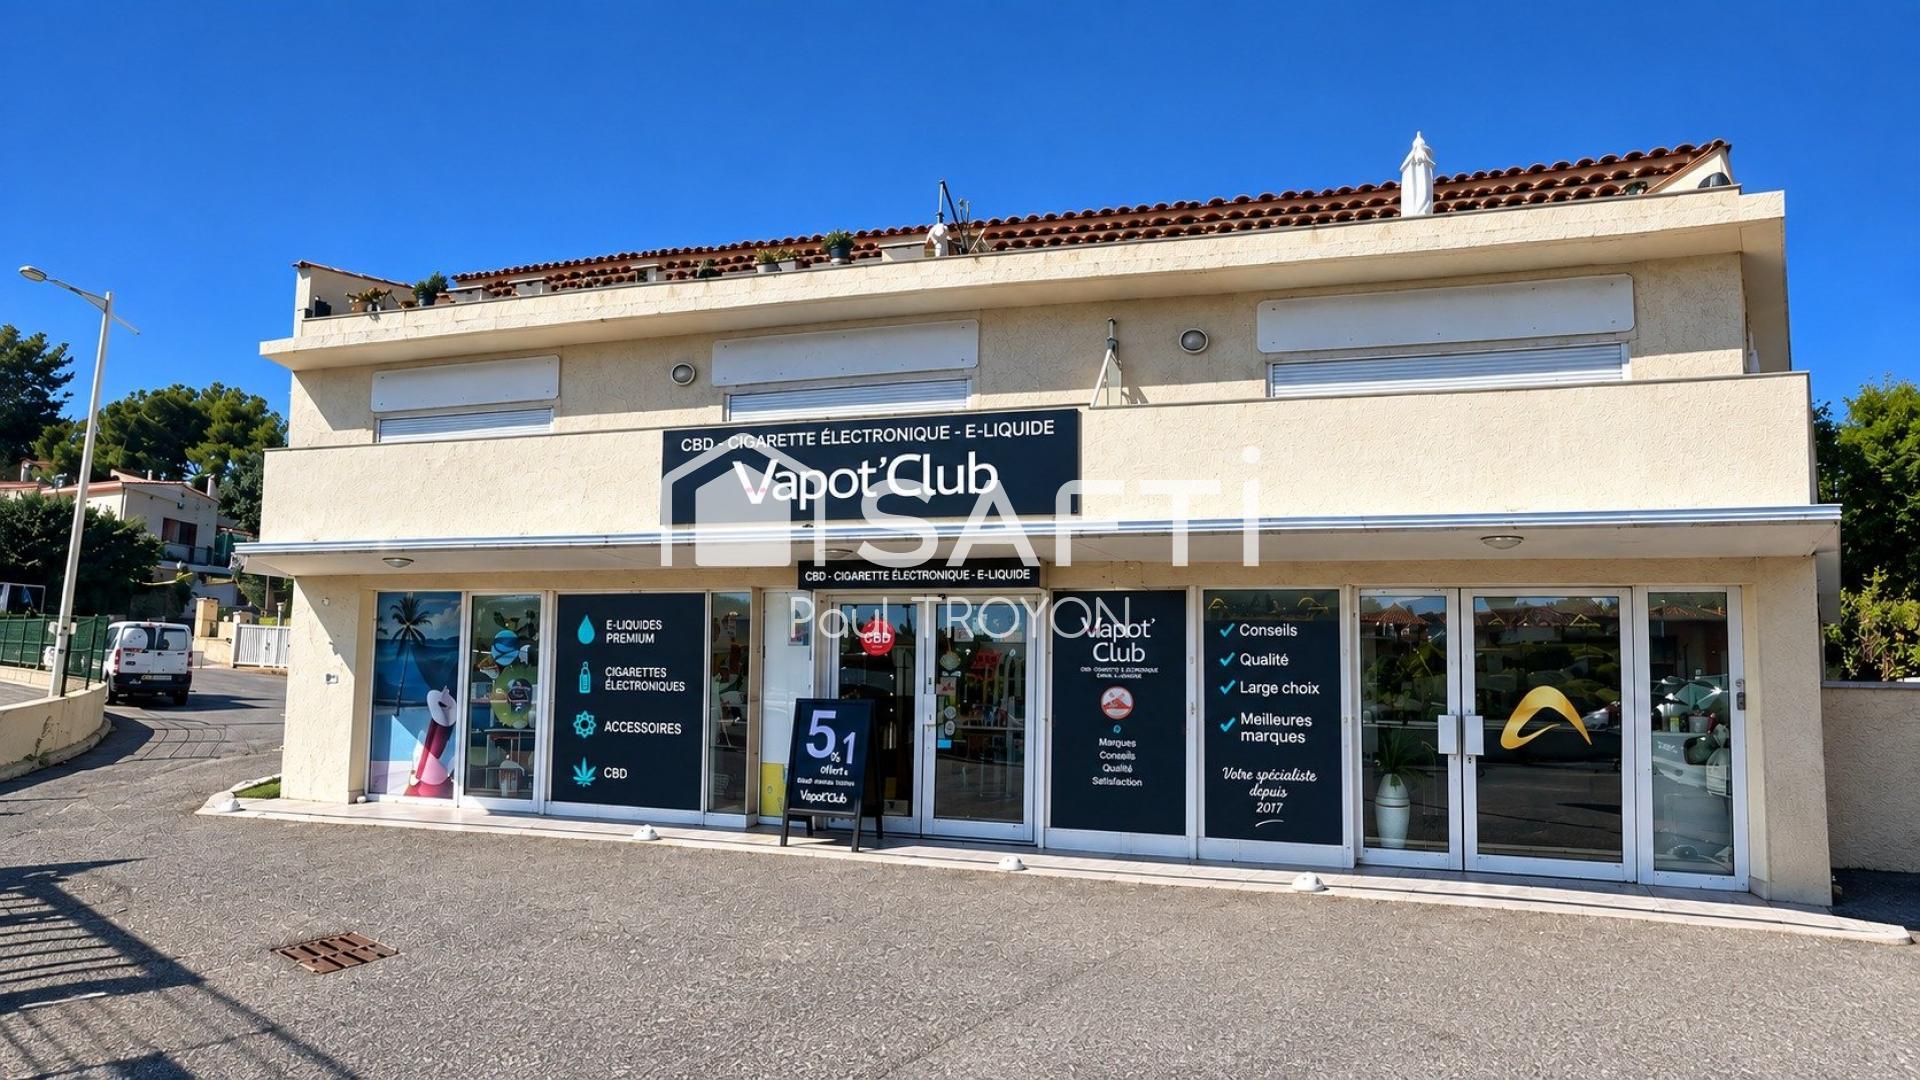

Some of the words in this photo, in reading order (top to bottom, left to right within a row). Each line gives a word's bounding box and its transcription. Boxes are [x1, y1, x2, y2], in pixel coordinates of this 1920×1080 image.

[681, 437, 714, 452] CBD
[728, 431, 816, 450] CIGARETTE
[821, 424, 950, 445] ÉLECTRONIQUE
[965, 419, 1055, 439] E-LIQUIDE
[805, 571, 827, 582] CBD
[834, 570, 890, 582] CIGARETTE
[892, 568, 970, 582] ÉLECTRONIQUE
[977, 569, 1031, 580] E-LIQUIDE
[606, 619, 663, 631] E-LIQUIDES
[1239, 623, 1298, 637] Conseils
[606, 633, 655, 644] PREMIUM
[864, 632, 892, 644] CBD
[1092, 642, 1146, 662] Club
[1240, 652, 1289, 667] Qualité
[605, 666, 667, 678] CIGARETTES
[605, 679, 686, 692] ÉLECTRONIQUES
[1240, 680, 1279, 697] Large
[1282, 680, 1320, 695] choix
[1240, 712, 1312, 727] Meilleures
[604, 721, 682, 735] ACCESSOIRES
[805, 710, 837, 758] 5
[843, 731, 856, 764] 1
[1240, 729, 1306, 746] marques
[604, 767, 628, 779] CBD
[1222, 767, 1253, 781] Votre
[1255, 768, 1318, 784] spécialiste
[1248, 782, 1288, 800] depuis
[1256, 802, 1284, 814] 2017
